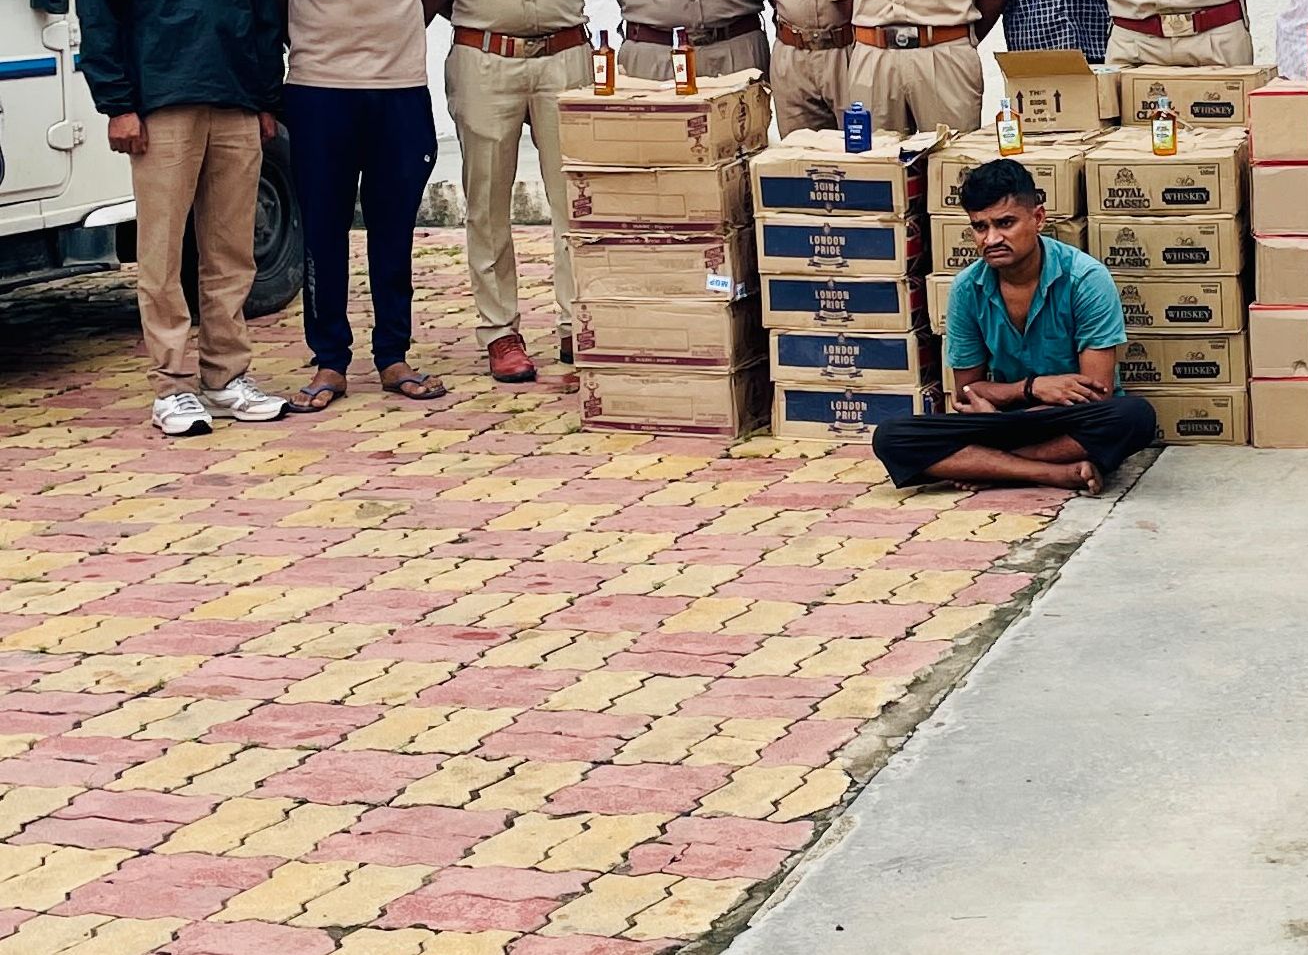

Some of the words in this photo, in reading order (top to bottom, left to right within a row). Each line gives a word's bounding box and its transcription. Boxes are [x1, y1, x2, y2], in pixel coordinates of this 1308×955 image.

[1192, 106, 1233, 114] WHISKEY
[1107, 186, 1145, 198] ROYAL
[1164, 192, 1208, 201] WHISKEY
[1103, 198, 1151, 209] CLASSIC
[809, 235, 846, 246] LONDON
[814, 245, 841, 256] PRIDE
[952, 247, 982, 258] ROYA
[1109, 246, 1146, 258] ROYAL
[1164, 252, 1208, 261] WHISKEY
[1104, 257, 1150, 268] CLASSIC
[814, 290, 850, 300] LONDON
[820, 299, 846, 309] PRIDE
[1122, 303, 1149, 315] OYAL
[1167, 309, 1211, 319] WHISKEY
[1124, 315, 1154, 326] ASSIC
[823, 344, 860, 355] LONDON
[828, 355, 855, 365] PRIDE
[1174, 366, 1218, 375] WHISKEY
[830, 400, 868, 411] LONDON
[835, 410, 863, 421] PRIDE
[1179, 424, 1220, 433] WHISKEY
